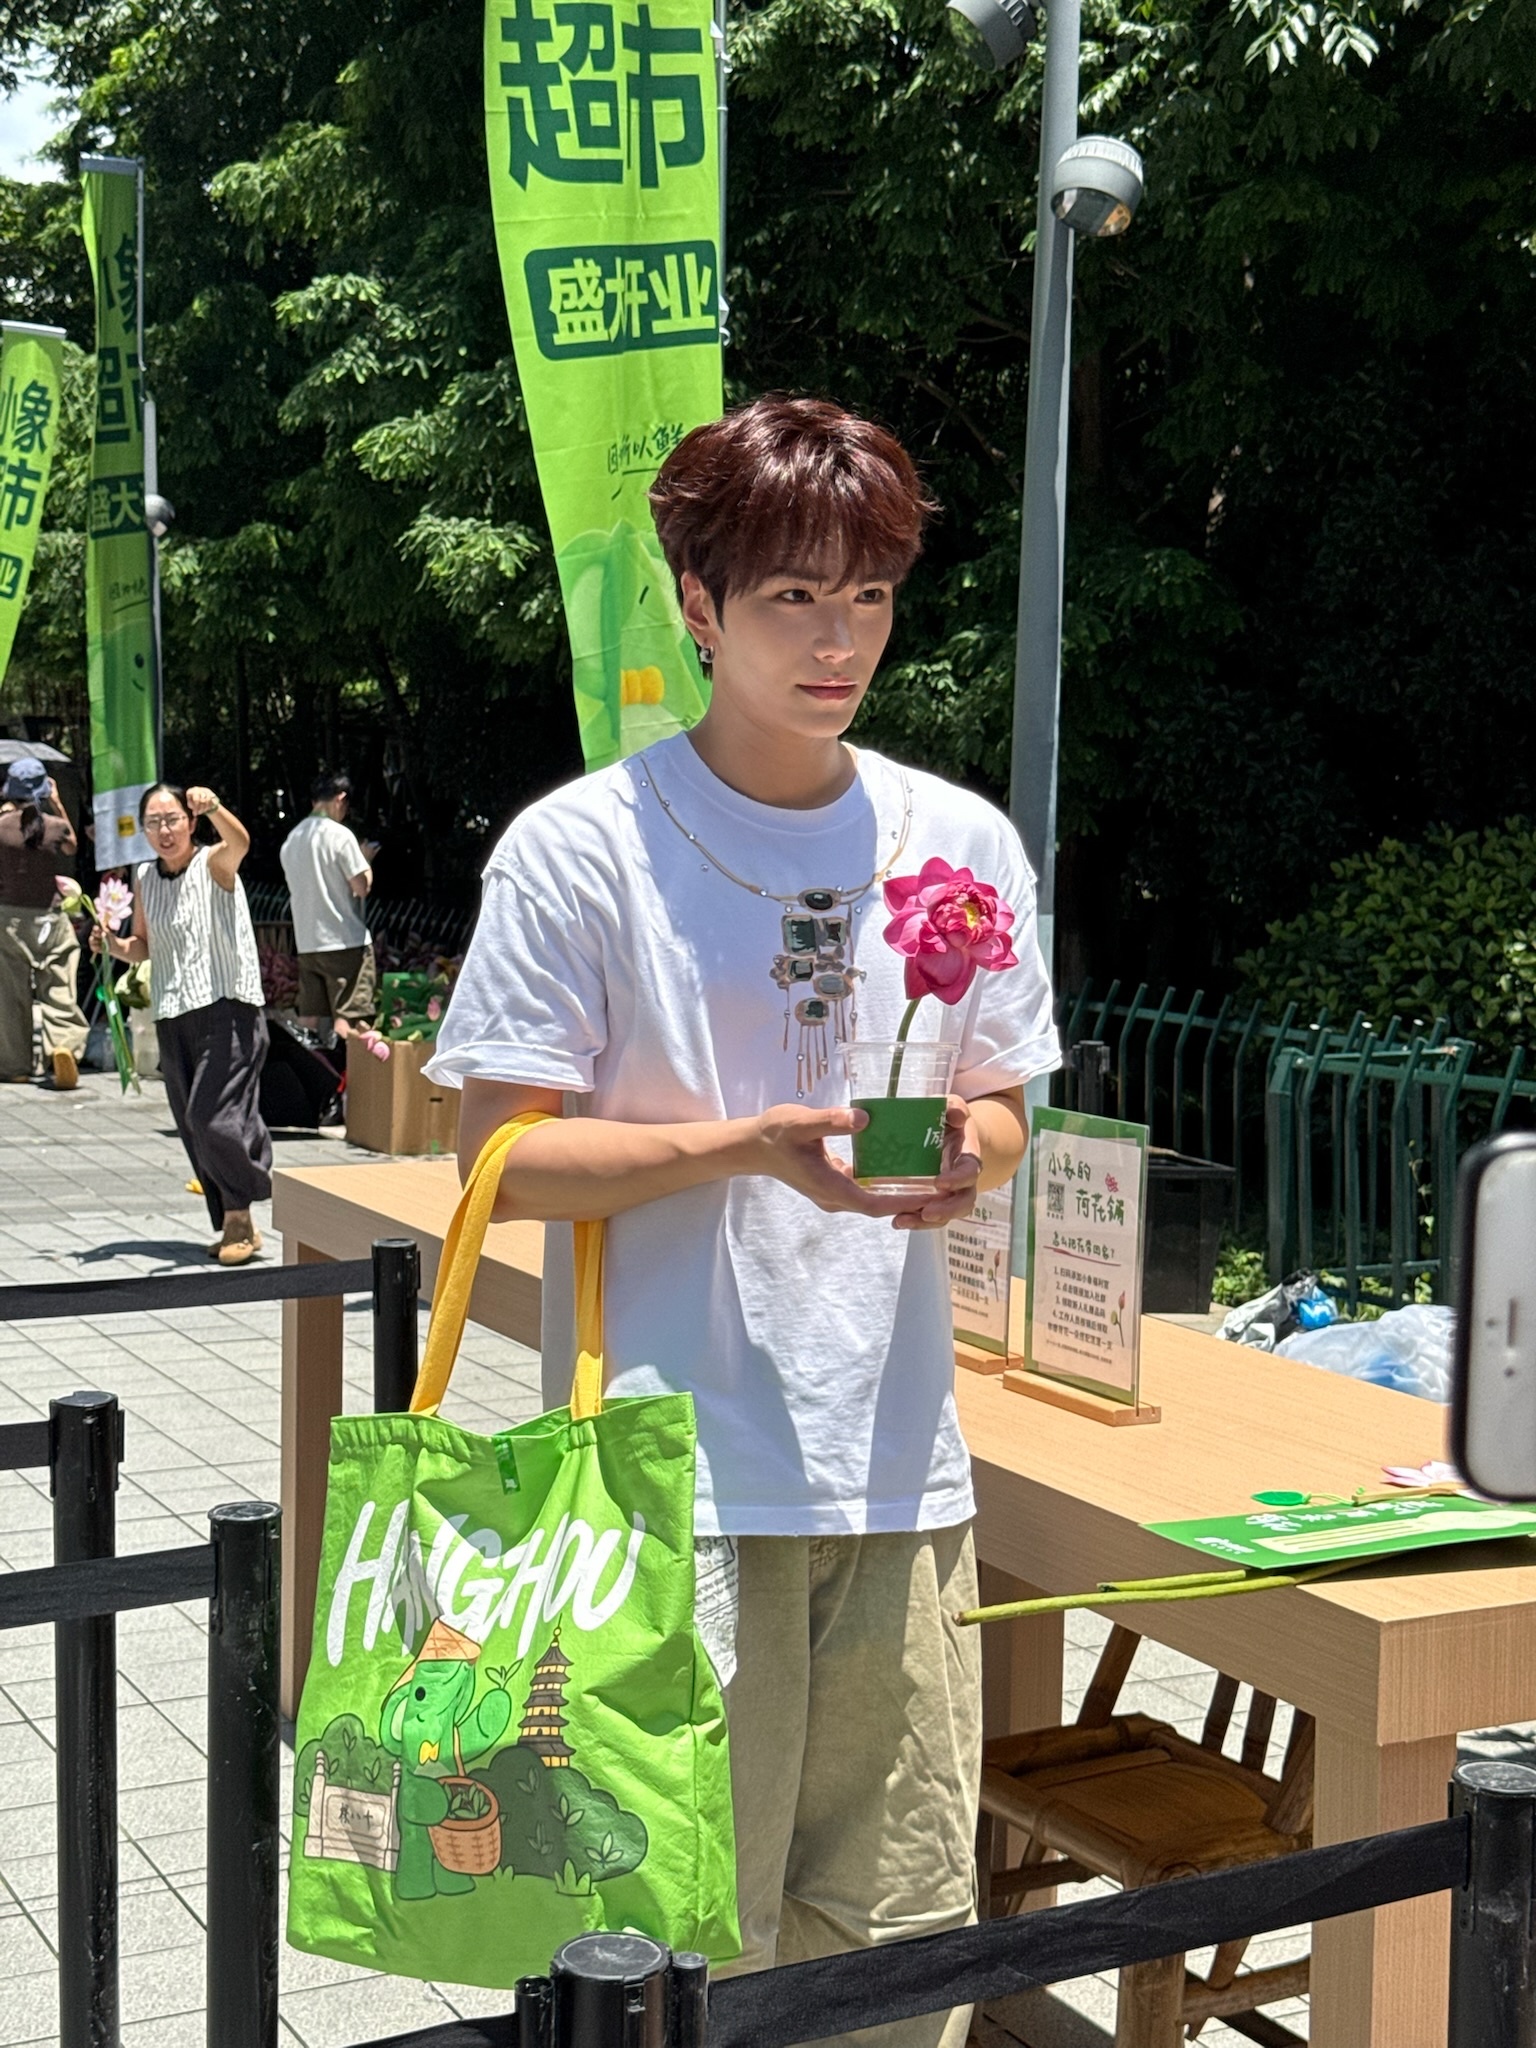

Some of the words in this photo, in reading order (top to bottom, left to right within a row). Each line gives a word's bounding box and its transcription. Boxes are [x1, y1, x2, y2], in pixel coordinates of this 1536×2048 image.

[499, 0, 707, 191] 超市
[0, 456, 42, 531] 市
[1048, 1152, 1091, 1182] 小象的
[1076, 1188, 1125, 1226] 荷花铺
